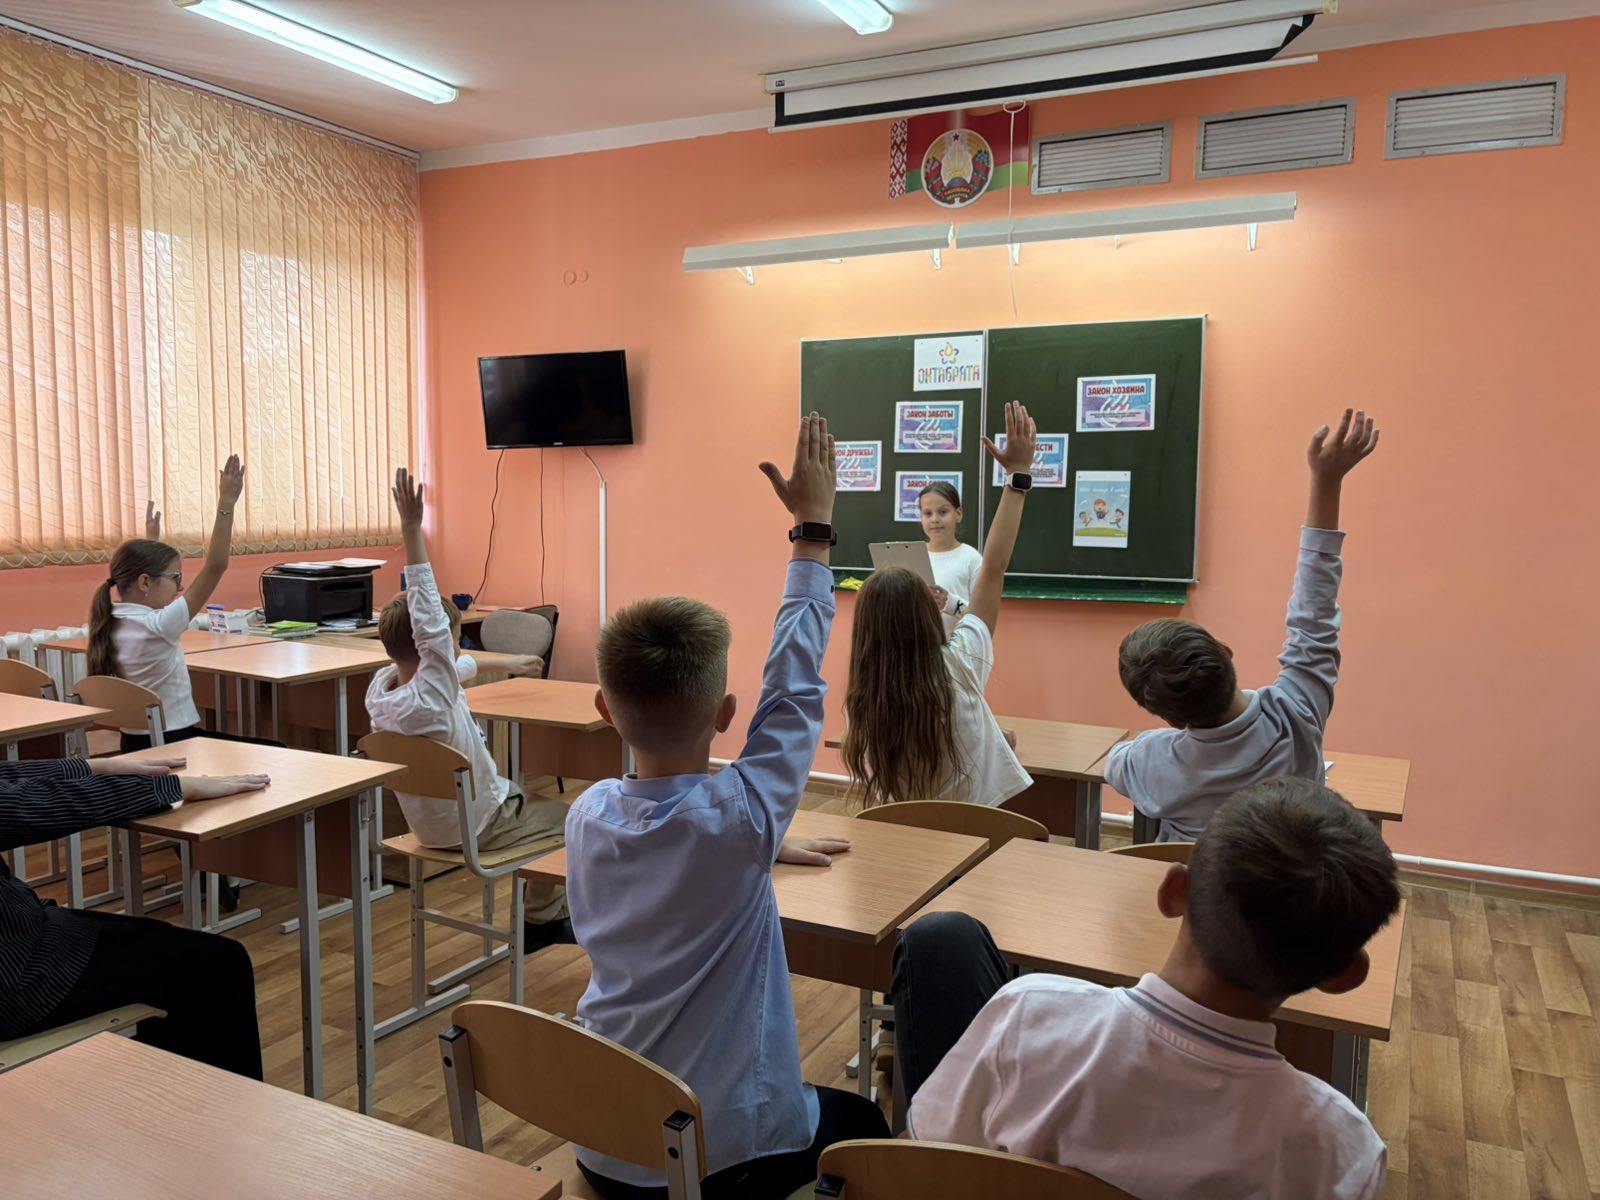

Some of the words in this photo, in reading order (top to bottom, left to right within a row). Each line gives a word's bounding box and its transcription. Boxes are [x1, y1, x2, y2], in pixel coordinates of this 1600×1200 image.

[1087, 386, 1111, 396] ЗАКОН
[1112, 385, 1145, 395] ХОЗЯИНА
[906, 410, 927, 419] ЗАКОН
[928, 410, 954, 418] ЗАБОТЫ
[1035, 443, 1053, 452] ЕСТИ
